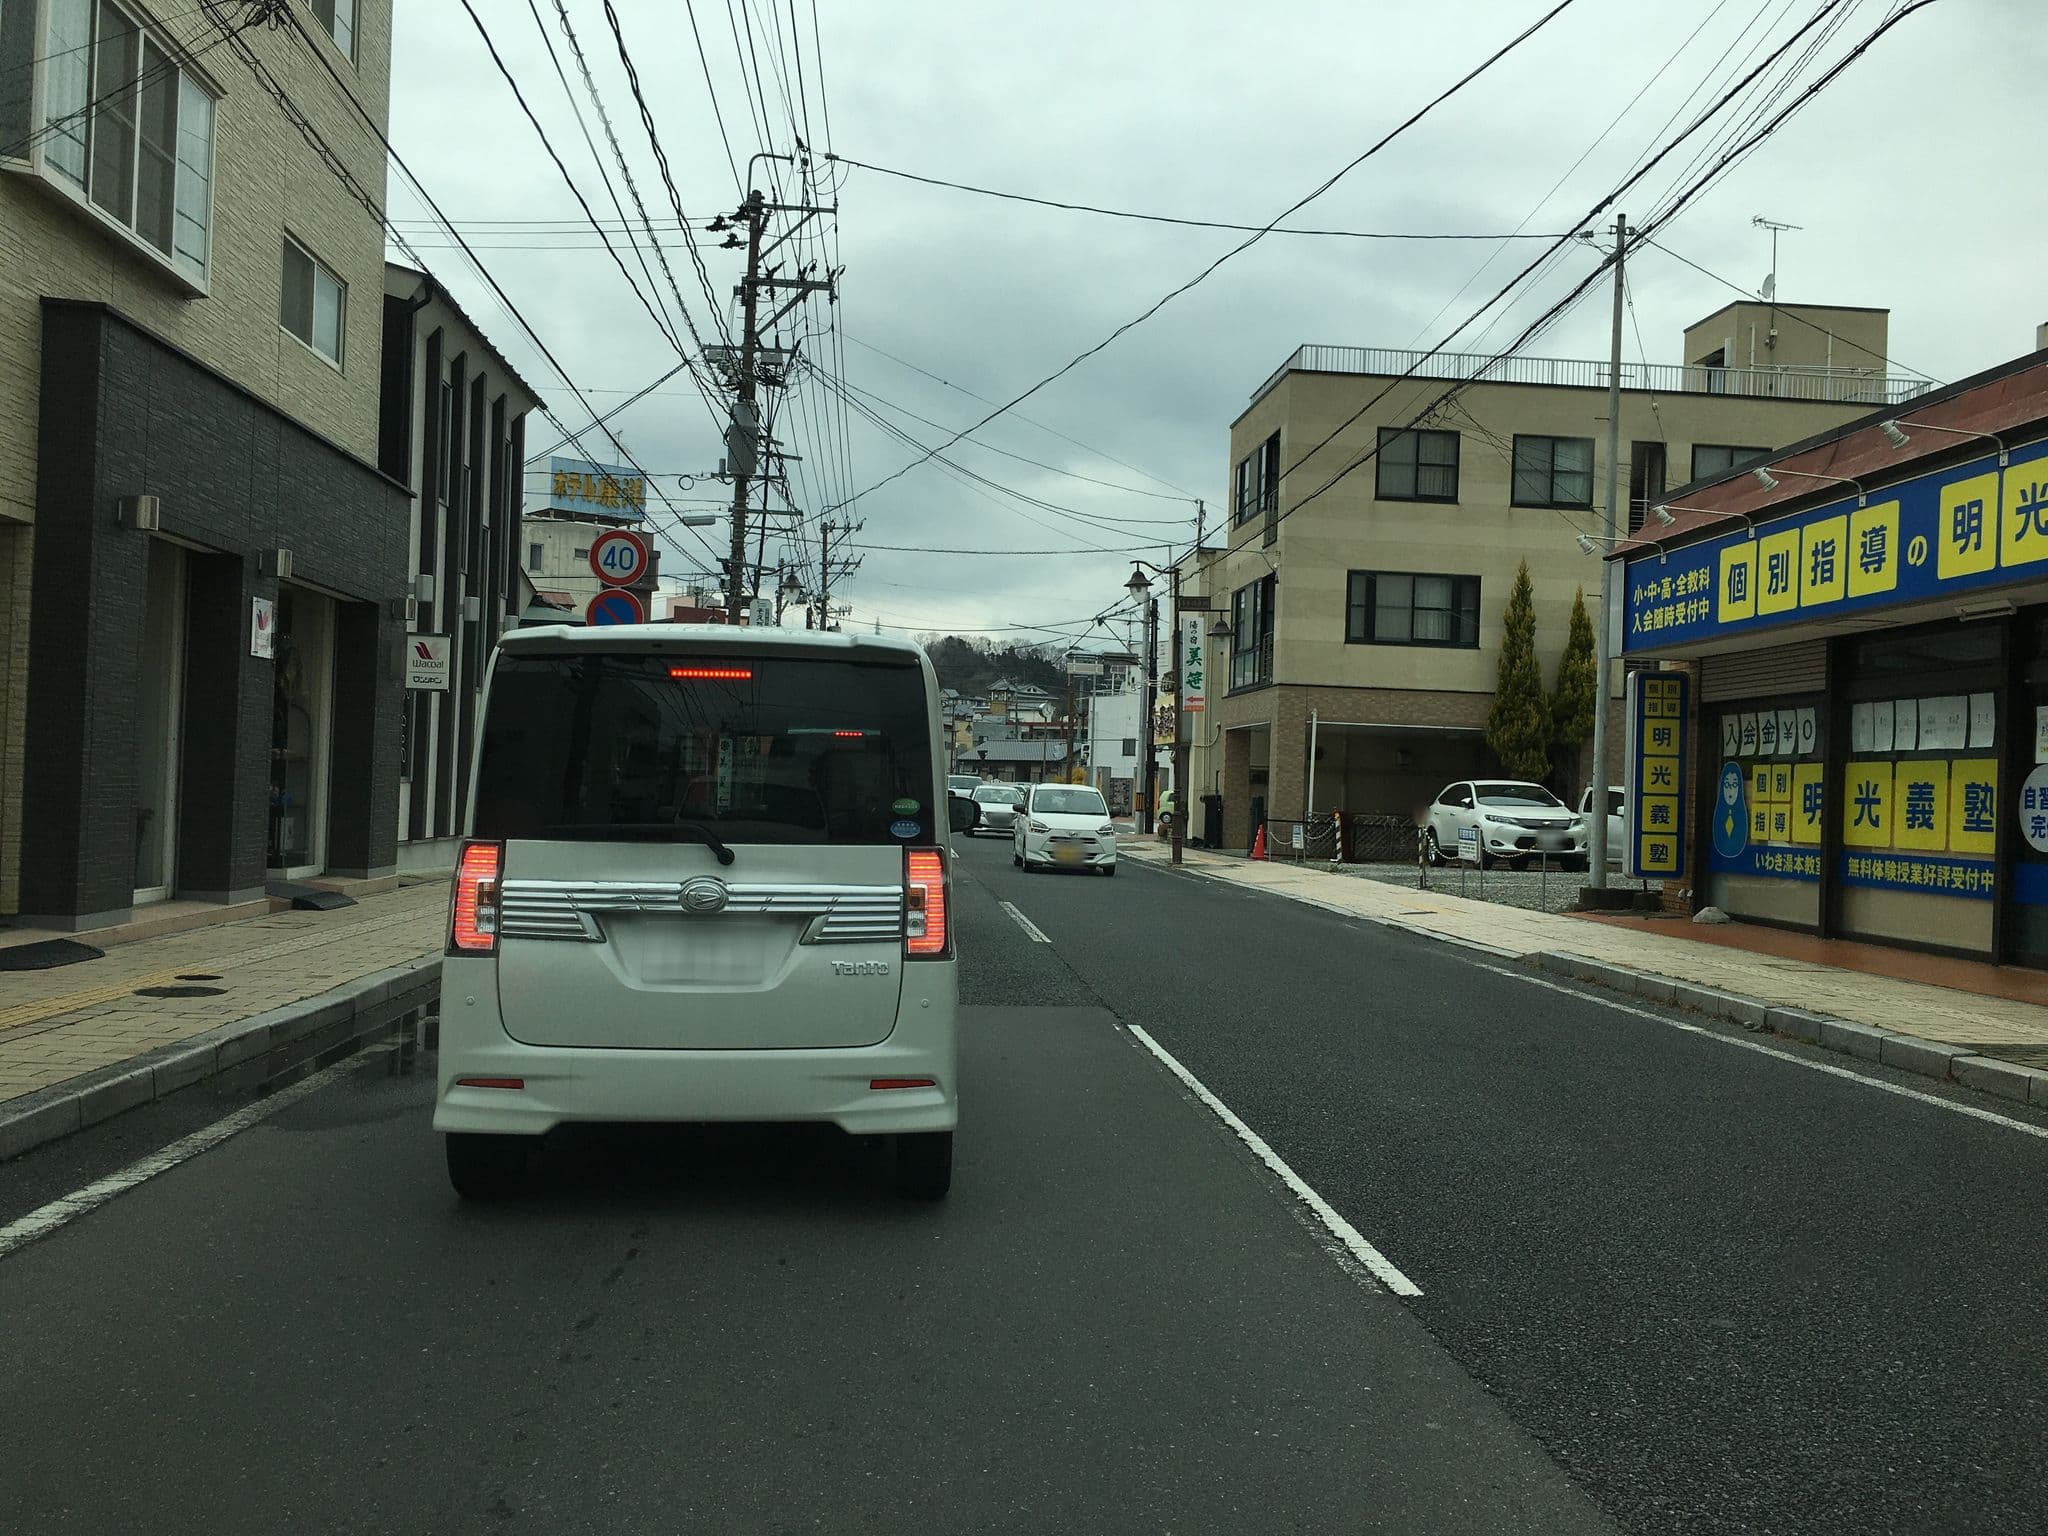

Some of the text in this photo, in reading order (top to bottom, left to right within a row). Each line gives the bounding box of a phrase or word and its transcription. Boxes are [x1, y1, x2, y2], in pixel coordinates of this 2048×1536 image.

[603, 546, 635, 571] 40
[1632, 596, 1710, 634] 入会随時受付中
[412, 658, 444, 669] Wacoal
[1650, 727, 1671, 864] 明光義塾
[1848, 856, 1994, 892] 無料体験授業好評受付中
